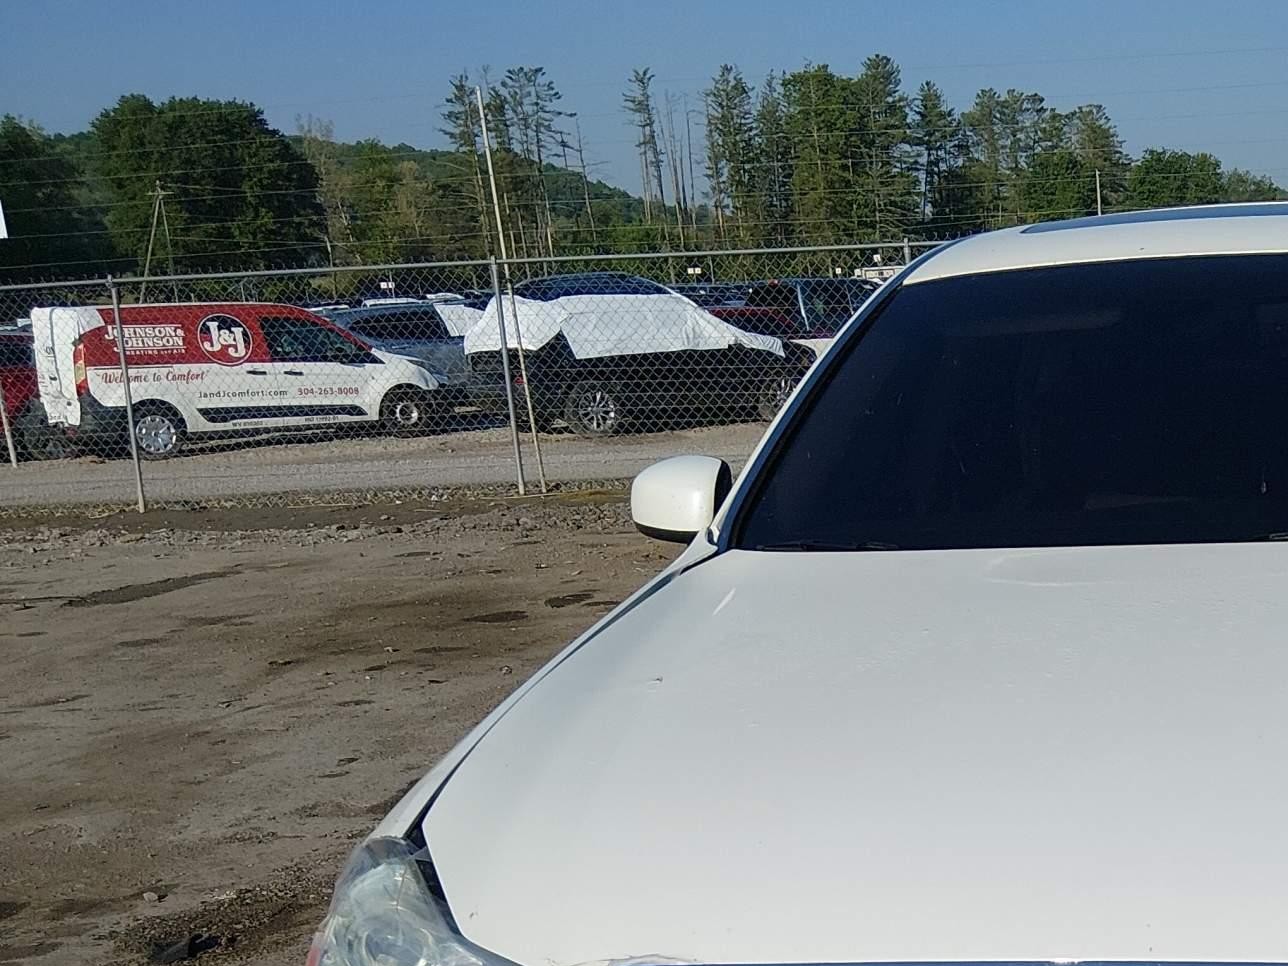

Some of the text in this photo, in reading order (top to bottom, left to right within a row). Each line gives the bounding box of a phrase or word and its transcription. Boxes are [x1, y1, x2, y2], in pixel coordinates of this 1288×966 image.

[203, 321, 246, 358] J&J
[101, 372, 149, 384] Welome
[152, 372, 162, 383] to
